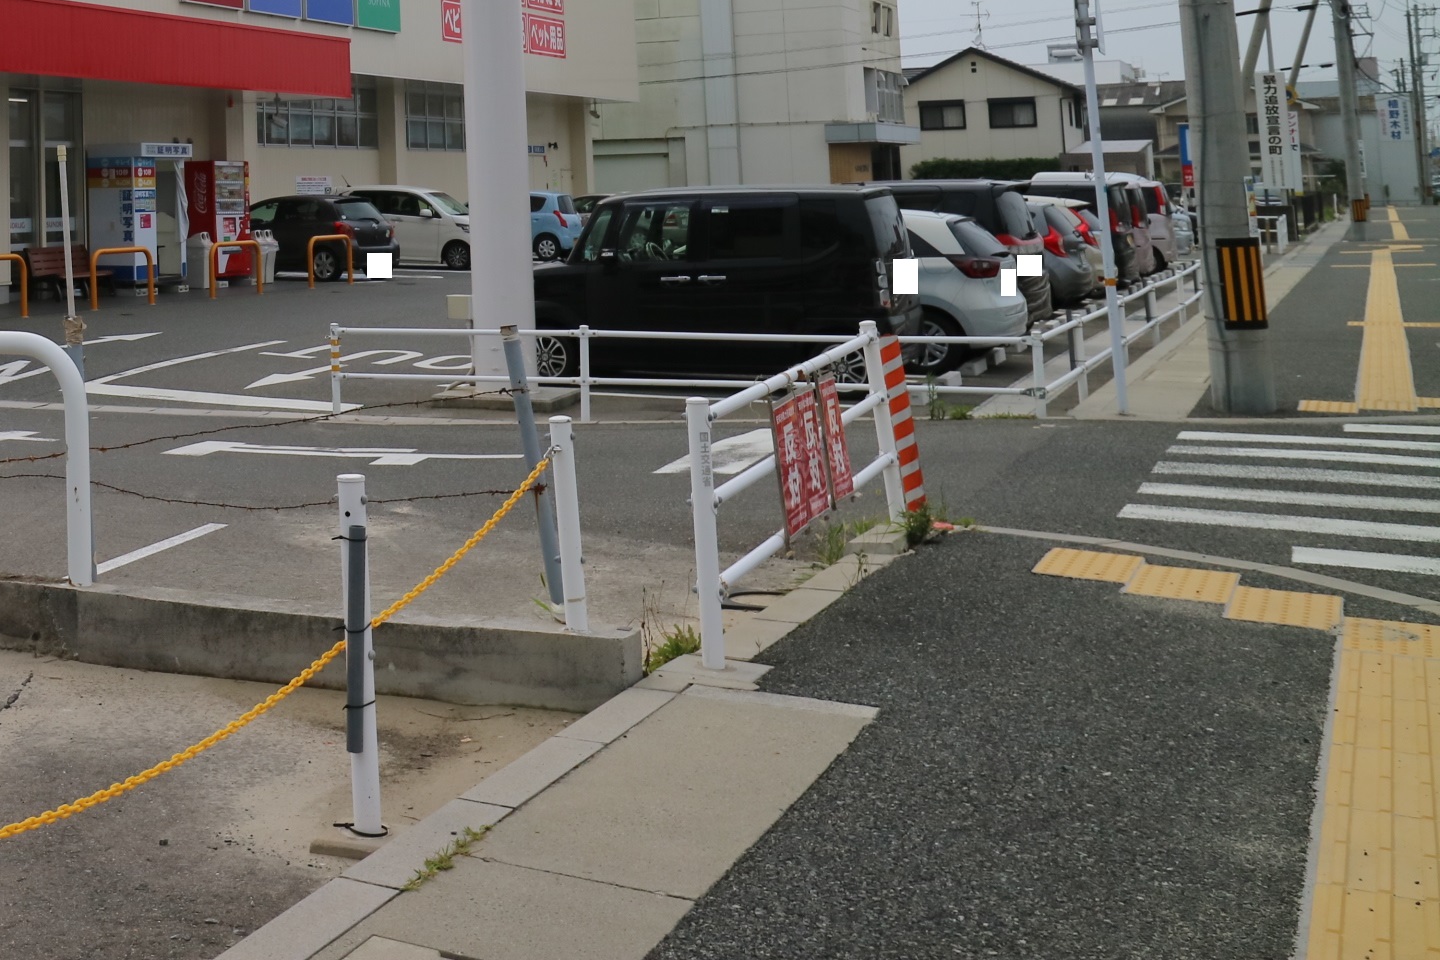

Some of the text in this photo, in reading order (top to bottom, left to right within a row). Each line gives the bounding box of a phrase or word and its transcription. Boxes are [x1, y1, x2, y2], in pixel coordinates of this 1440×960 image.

[1263, 75, 1282, 155] 暴力追放宣言の町
[783, 421, 802, 509] 反対
[804, 410, 822, 492] 反対
[827, 398, 847, 476] 反対
